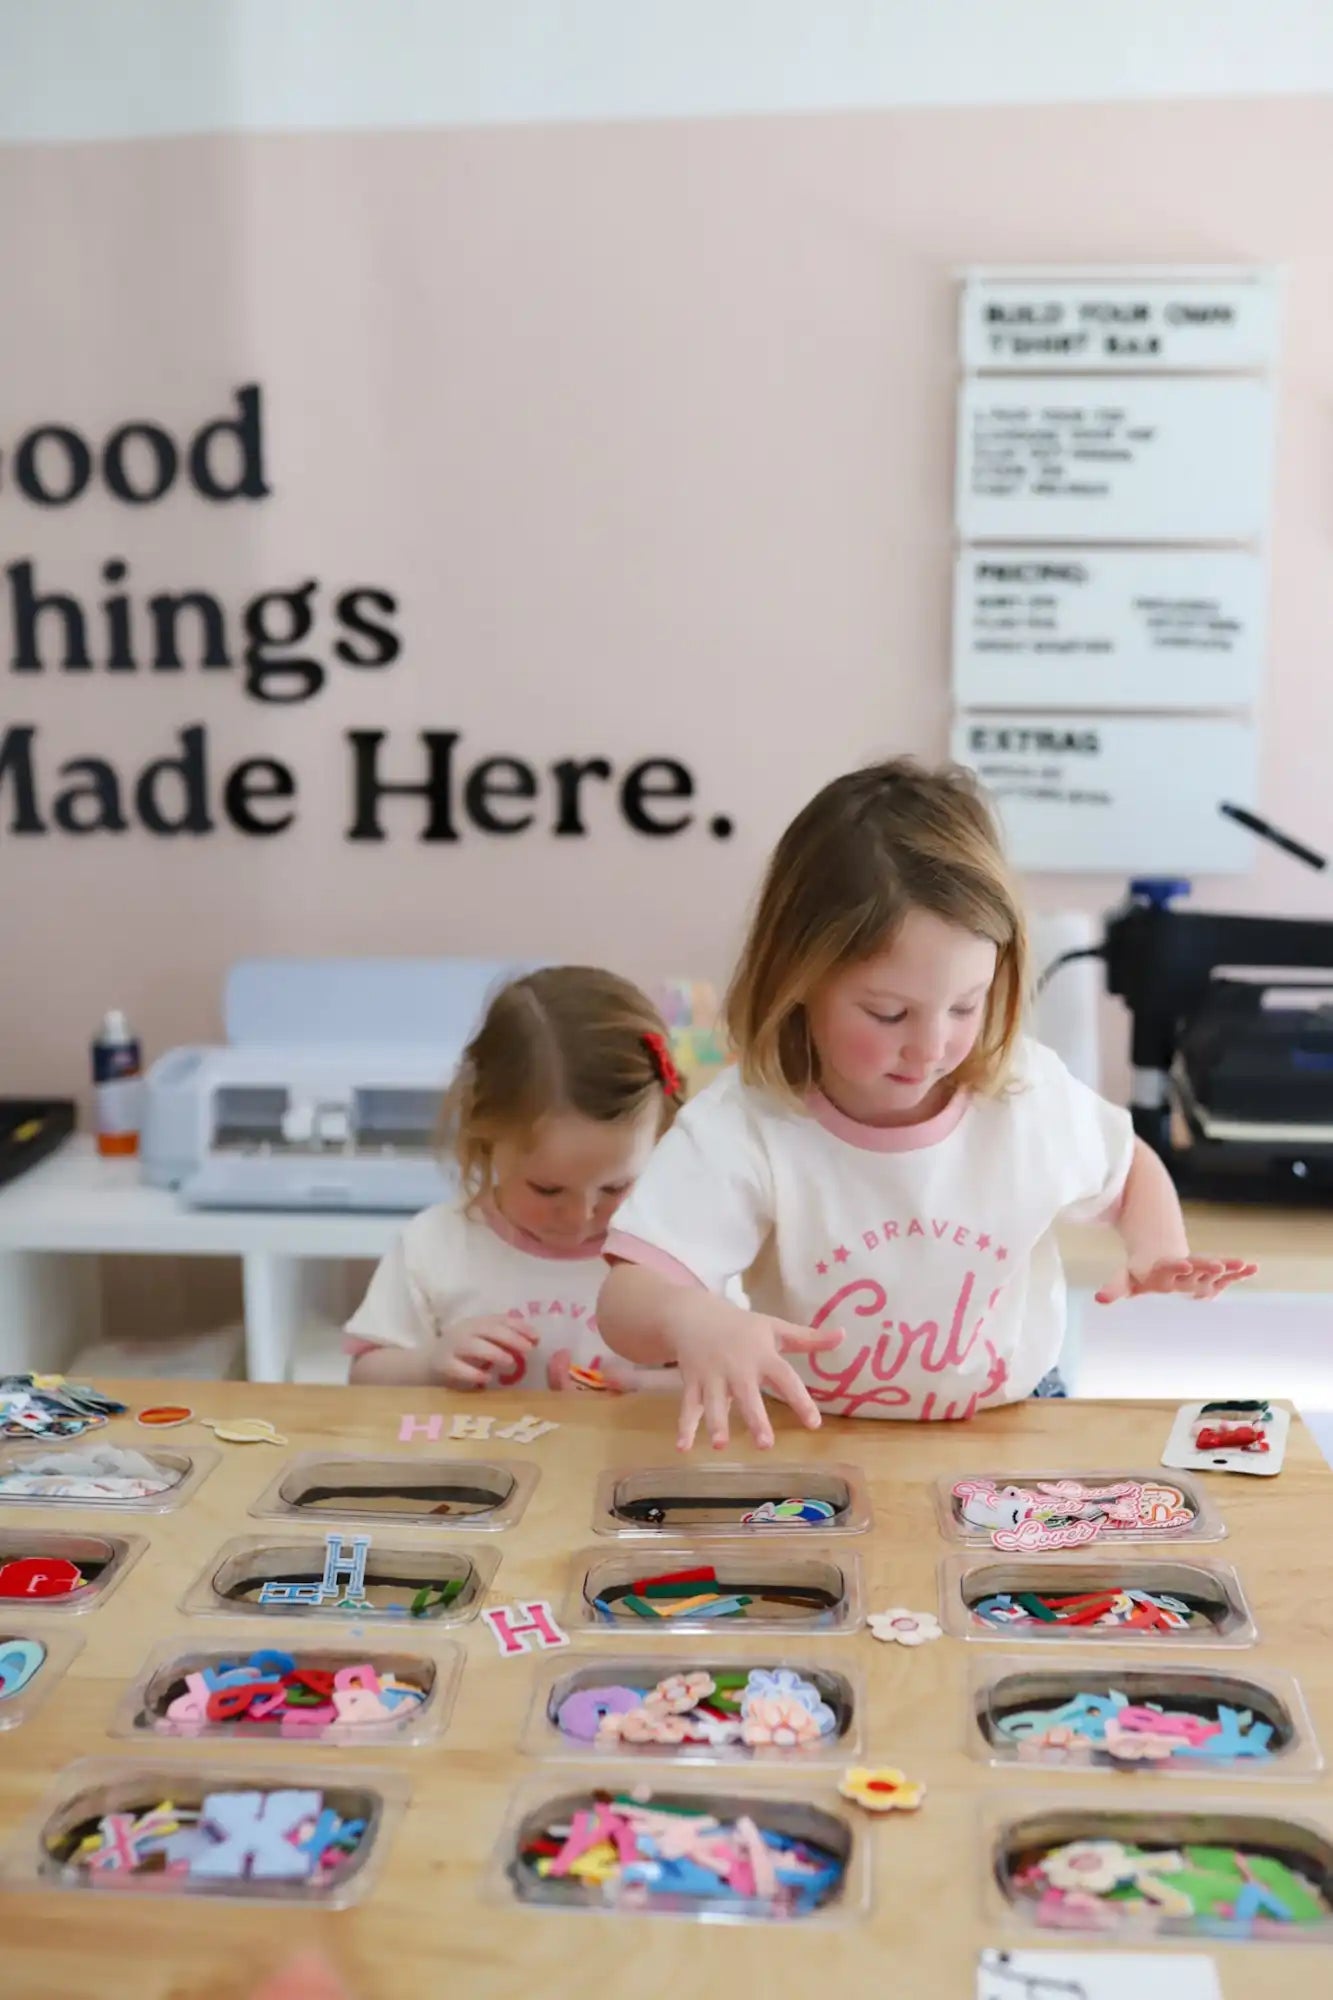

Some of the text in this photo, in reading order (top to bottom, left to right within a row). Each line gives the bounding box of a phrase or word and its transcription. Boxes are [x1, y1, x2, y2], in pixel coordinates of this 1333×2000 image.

[0, 384, 271, 507] ood
[345, 729, 734, 844] Here.
[861, 1218, 970, 1251] BRAVE
[322, 1533, 371, 1599] H
[488, 1603, 563, 1653] H
